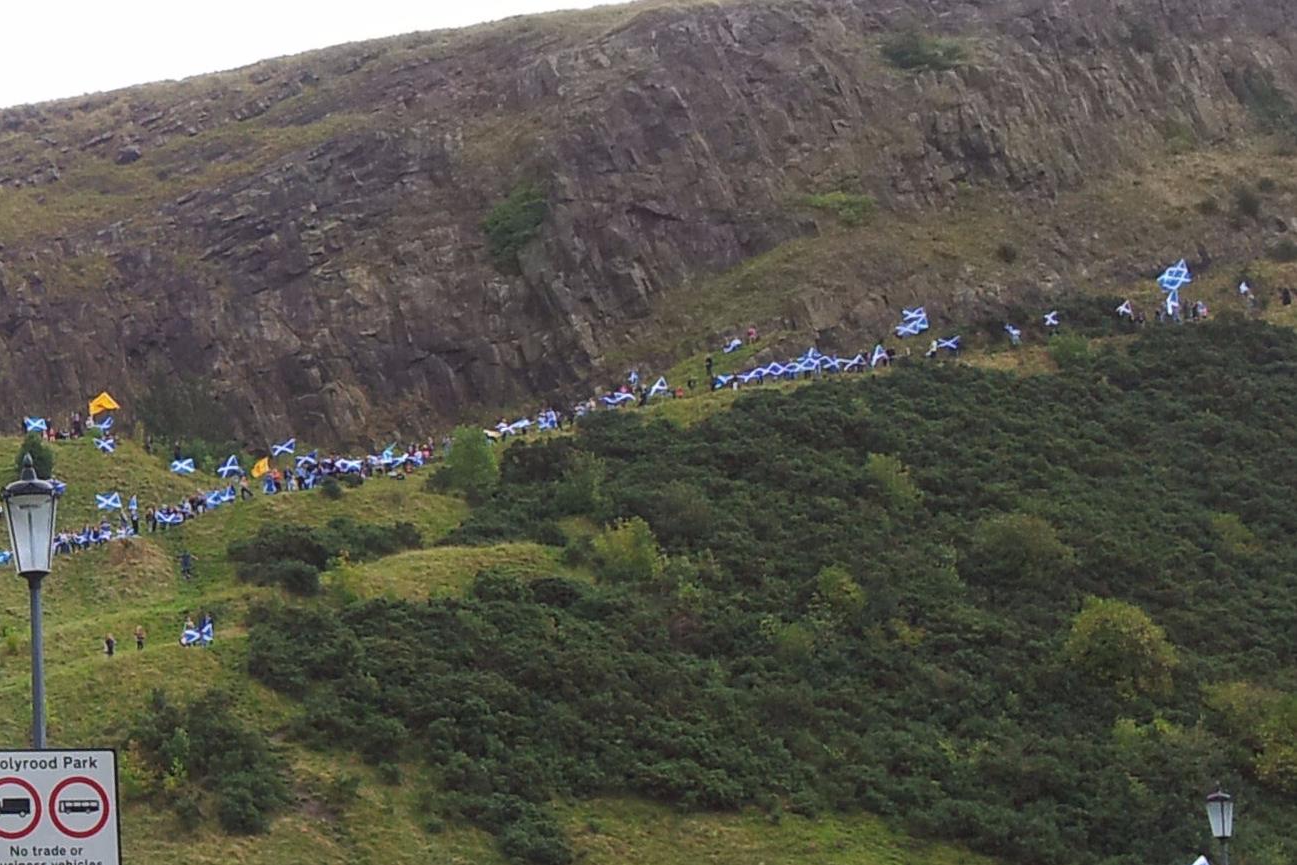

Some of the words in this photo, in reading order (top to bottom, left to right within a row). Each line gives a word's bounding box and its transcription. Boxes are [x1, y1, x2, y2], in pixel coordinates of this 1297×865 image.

[63, 756, 98, 769] Park
[10, 846, 28, 856] No
[32, 845, 66, 856] trade
[70, 847, 83, 856] or
